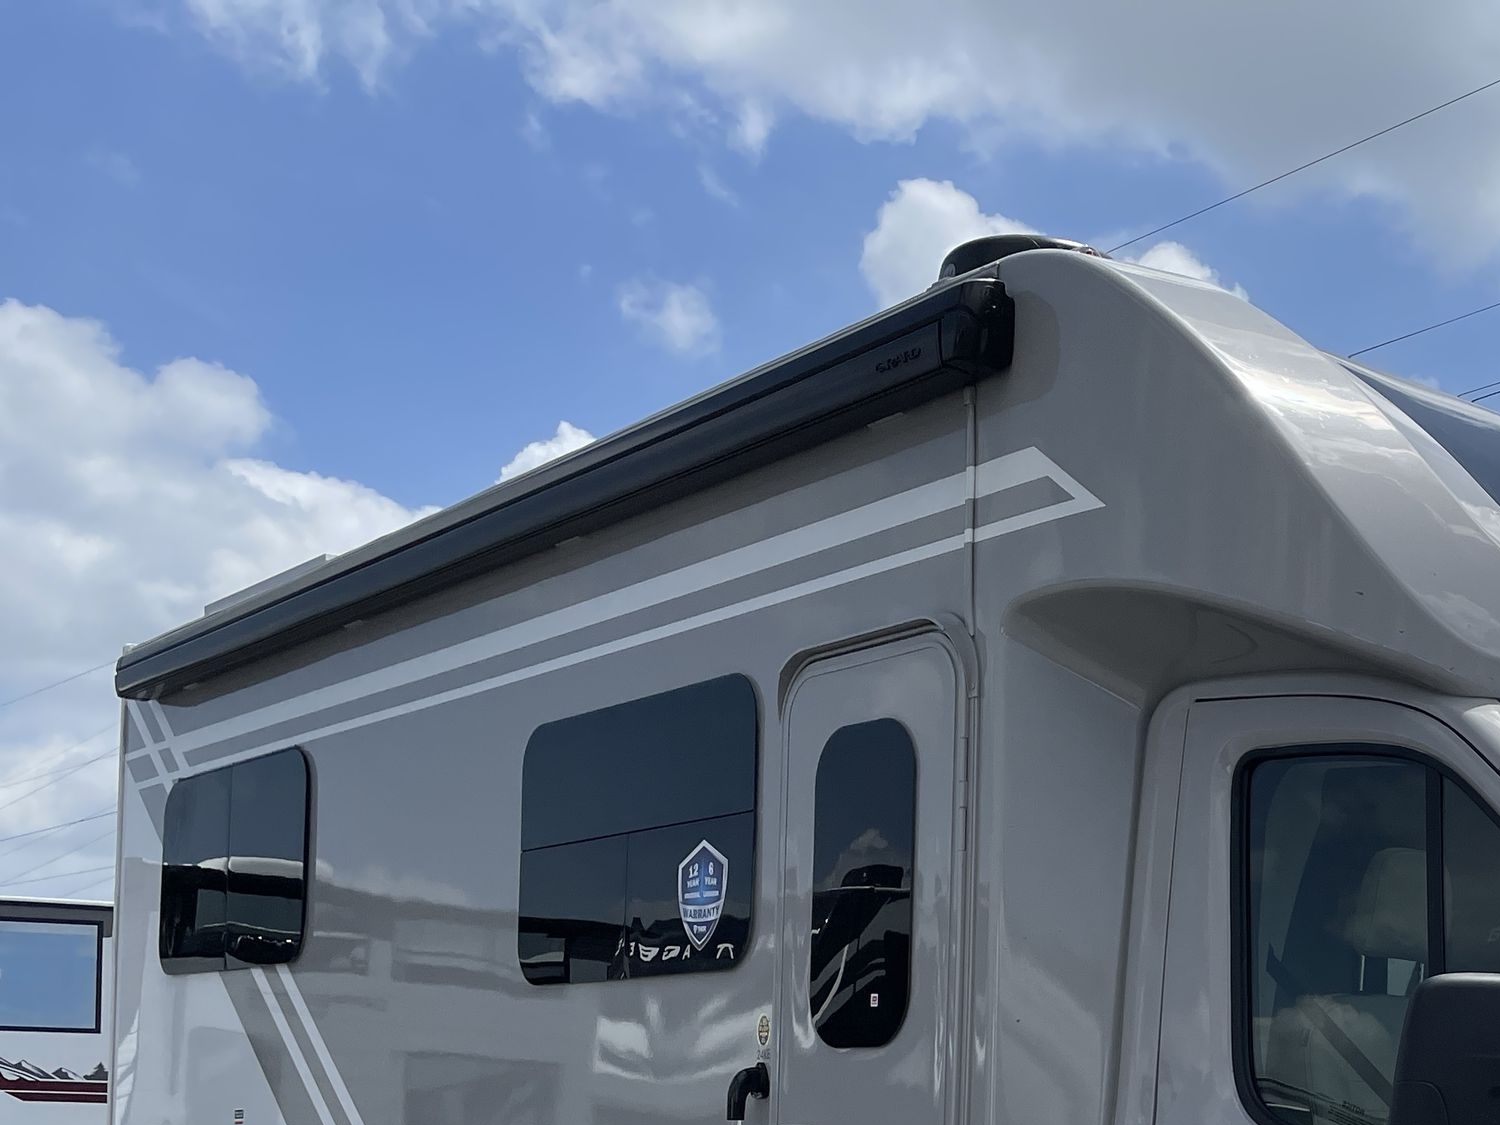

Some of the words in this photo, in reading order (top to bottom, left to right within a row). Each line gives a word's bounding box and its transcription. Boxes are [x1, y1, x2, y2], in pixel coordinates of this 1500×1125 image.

[688, 862, 699, 879] 12
[708, 861, 714, 876] 6
[686, 878, 700, 889] YEAR
[704, 876, 717, 886] YEAR
[682, 907, 720, 919] WARRANTY
